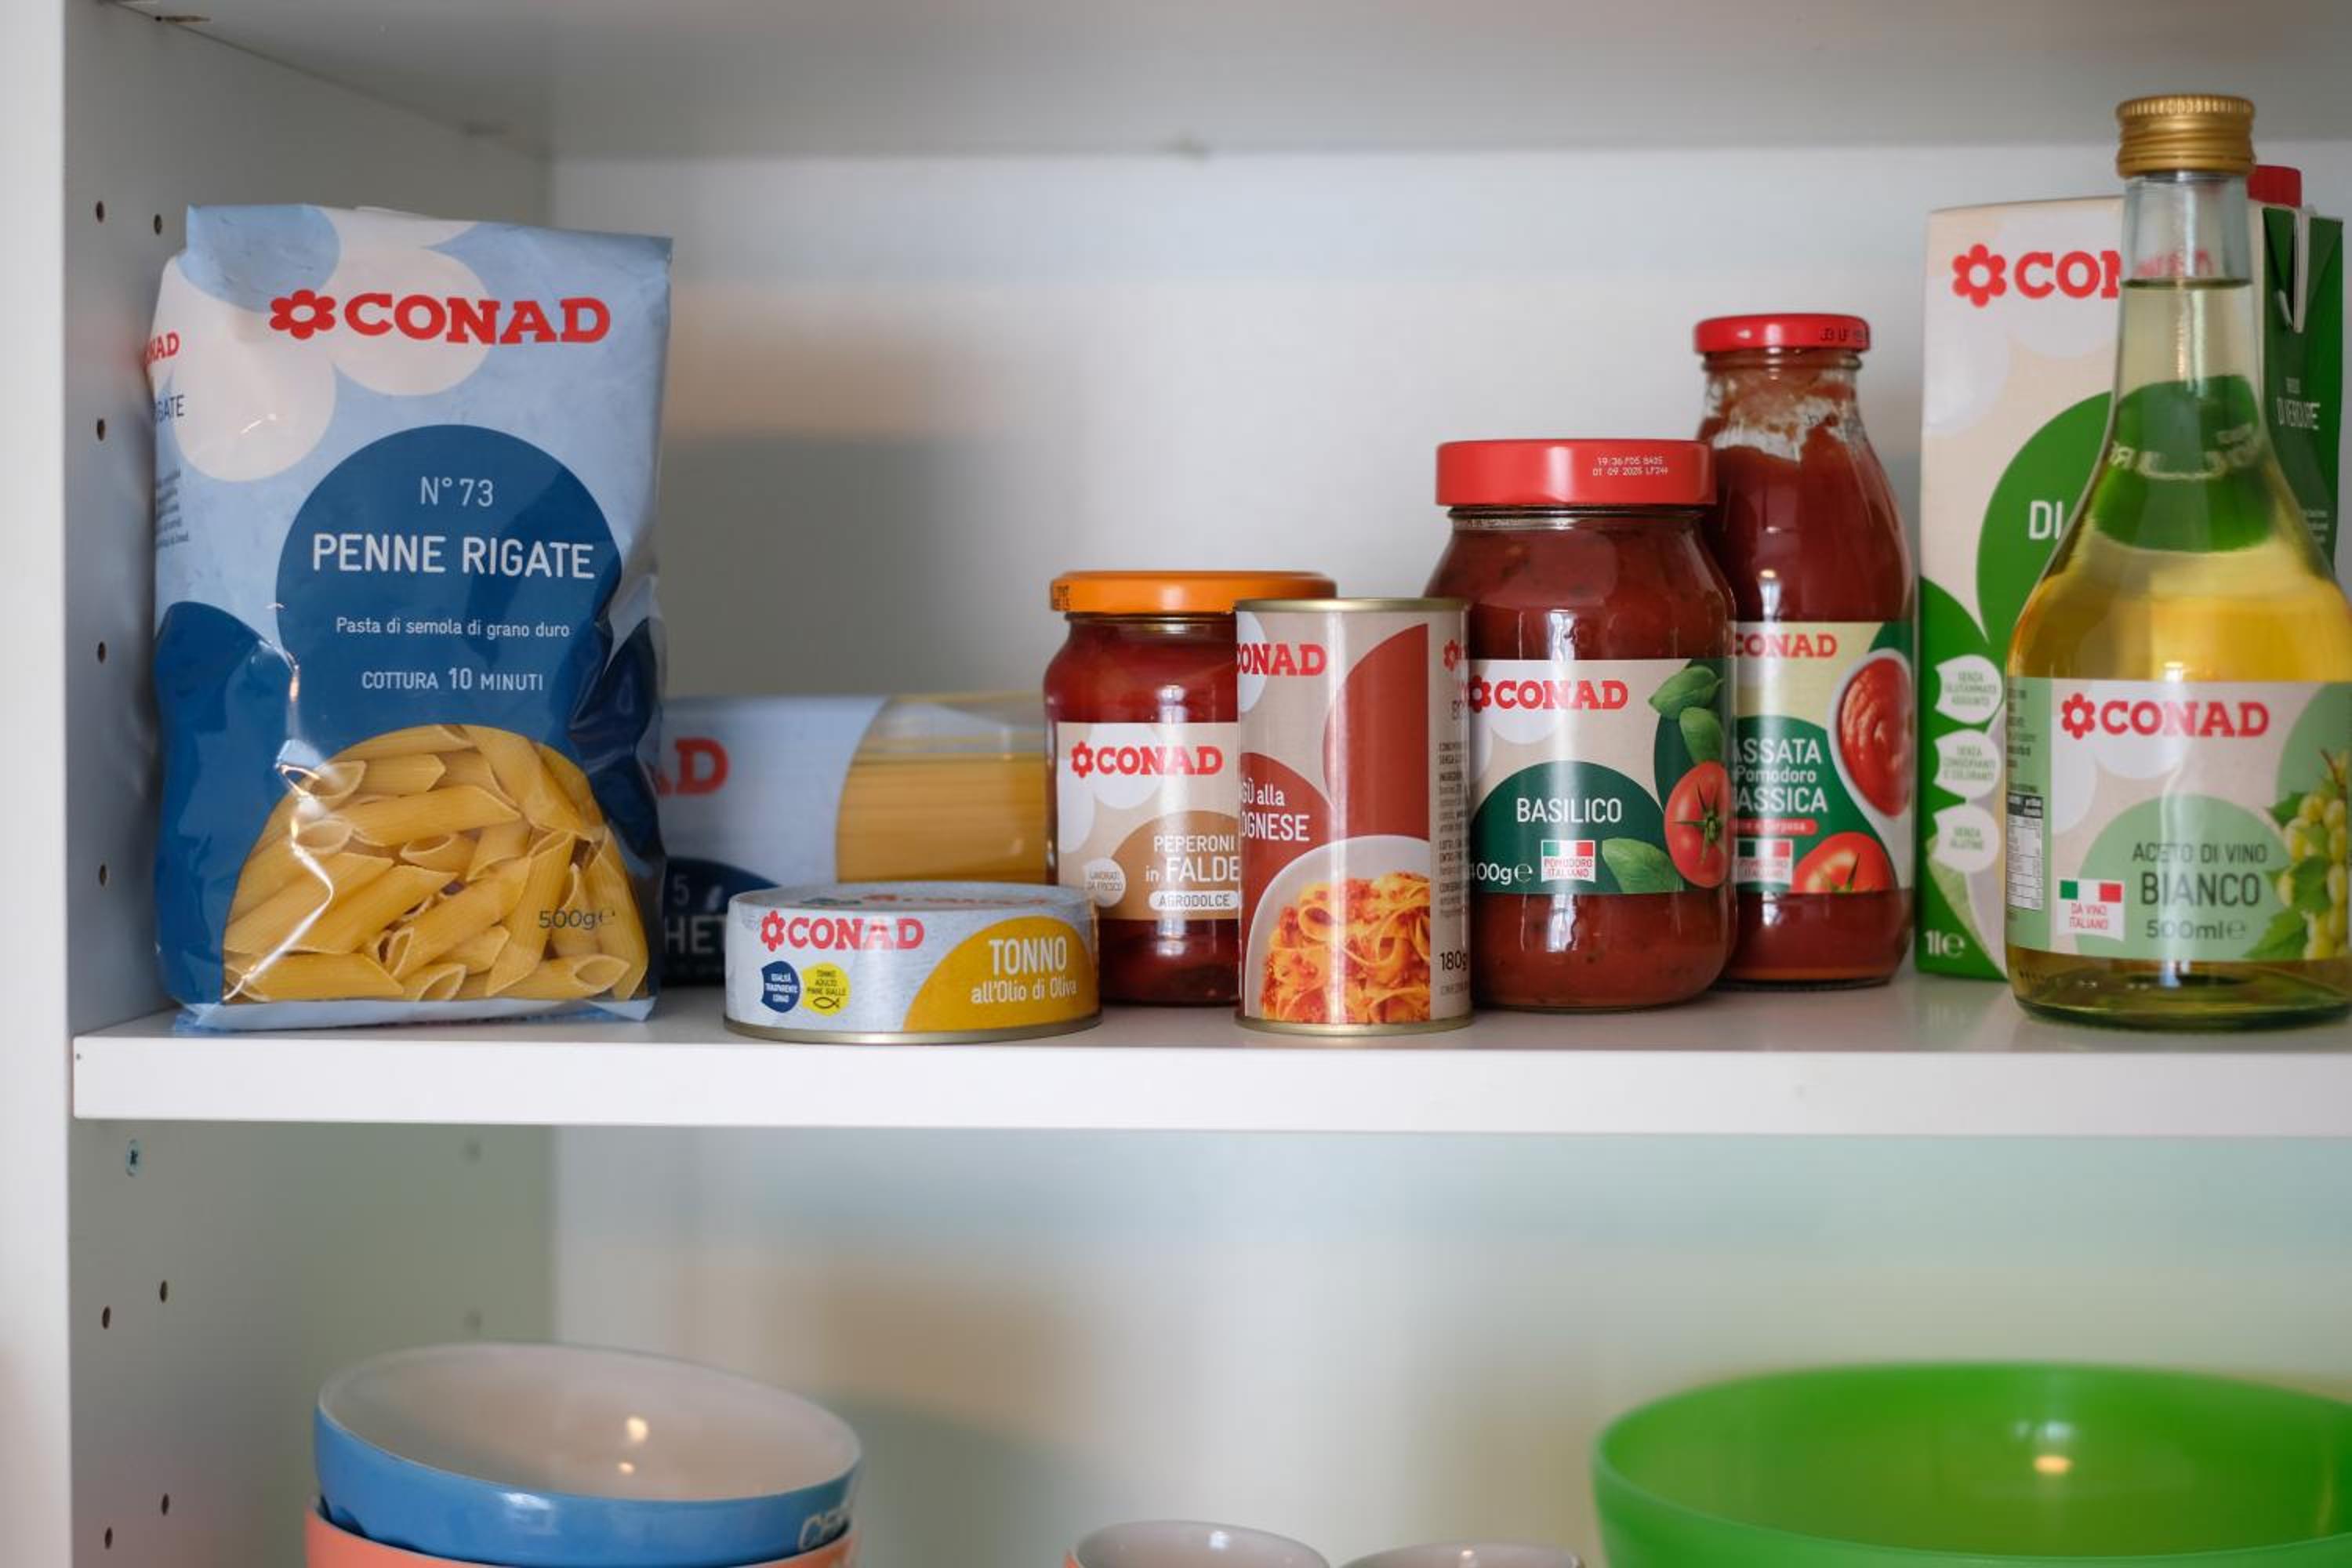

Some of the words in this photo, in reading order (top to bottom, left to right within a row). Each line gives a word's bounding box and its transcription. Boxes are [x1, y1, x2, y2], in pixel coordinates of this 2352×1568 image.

[343, 293, 611, 343] CONAD
[2028, 500, 2063, 540] DI
[313, 533, 447, 573] PENNE
[461, 536, 596, 579] RIGATE
[336, 616, 382, 634] Pasta
[386, 617, 401, 634] di
[405, 619, 463, 636] semola
[467, 619, 481, 636] di
[487, 624, 530, 641] grano
[535, 622, 570, 638] duro
[361, 671, 439, 691] COTTURA
[448, 668, 472, 690] 10
[481, 674, 544, 691] MINUTI
[1494, 679, 1629, 710] CONAD
[2100, 700, 2270, 738] CONAD
[1097, 746, 1224, 775] CONAD
[1256, 783, 1286, 806] alla
[1516, 797, 1623, 823] BASILICO
[1153, 835, 1236, 854] PEPERONI
[2200, 844, 2220, 863] DI
[2224, 843, 2268, 863] VINO
[1145, 866, 1160, 883] in
[1166, 856, 1240, 883] FALDE
[2141, 872, 2261, 907] BIANCO
[787, 916, 925, 951] CONAD
[989, 937, 1068, 977] TONNO
[1032, 978, 1046, 1000] di
[1050, 977, 1077, 999] Oliva
